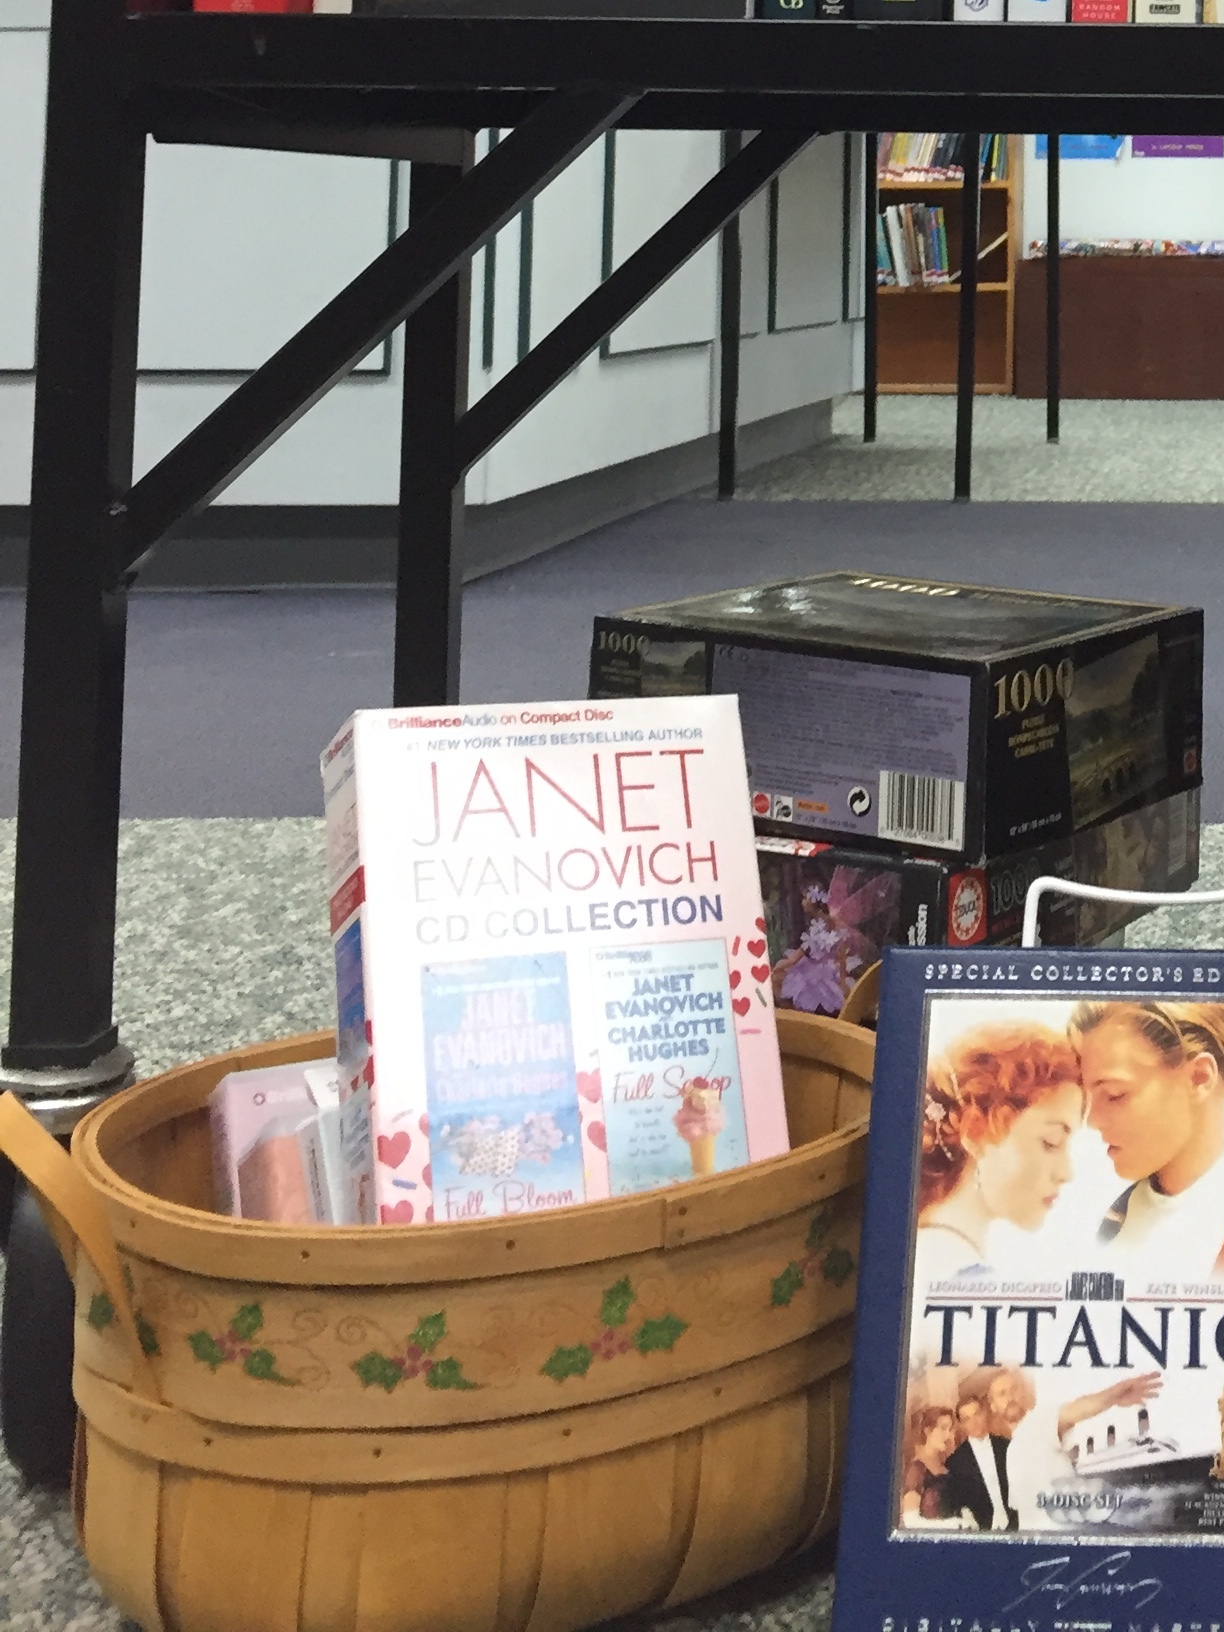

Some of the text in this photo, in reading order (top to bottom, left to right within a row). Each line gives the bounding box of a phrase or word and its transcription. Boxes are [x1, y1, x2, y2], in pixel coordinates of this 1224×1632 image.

[1077, 3, 1122, 12] RANDOM
[993, 656, 1075, 720] 1000
[411, 748, 705, 848] JANET
[411, 839, 720, 904] EVANOVICH
[415, 893, 725, 946] CD COLLECTION
[632, 972, 696, 998] JANET
[923, 962, 1020, 981] SPECIAL
[1029, 964, 1184, 984] COLLECTOR'S
[604, 991, 725, 1021] EVANOVICH
[607, 1017, 727, 1046] CHARLOTTE
[627, 1038, 711, 1064] HUGHES
[927, 1281, 1063, 1295] LEONARDO DICAPRIO
[1145, 1283, 1177, 1296] KATE
